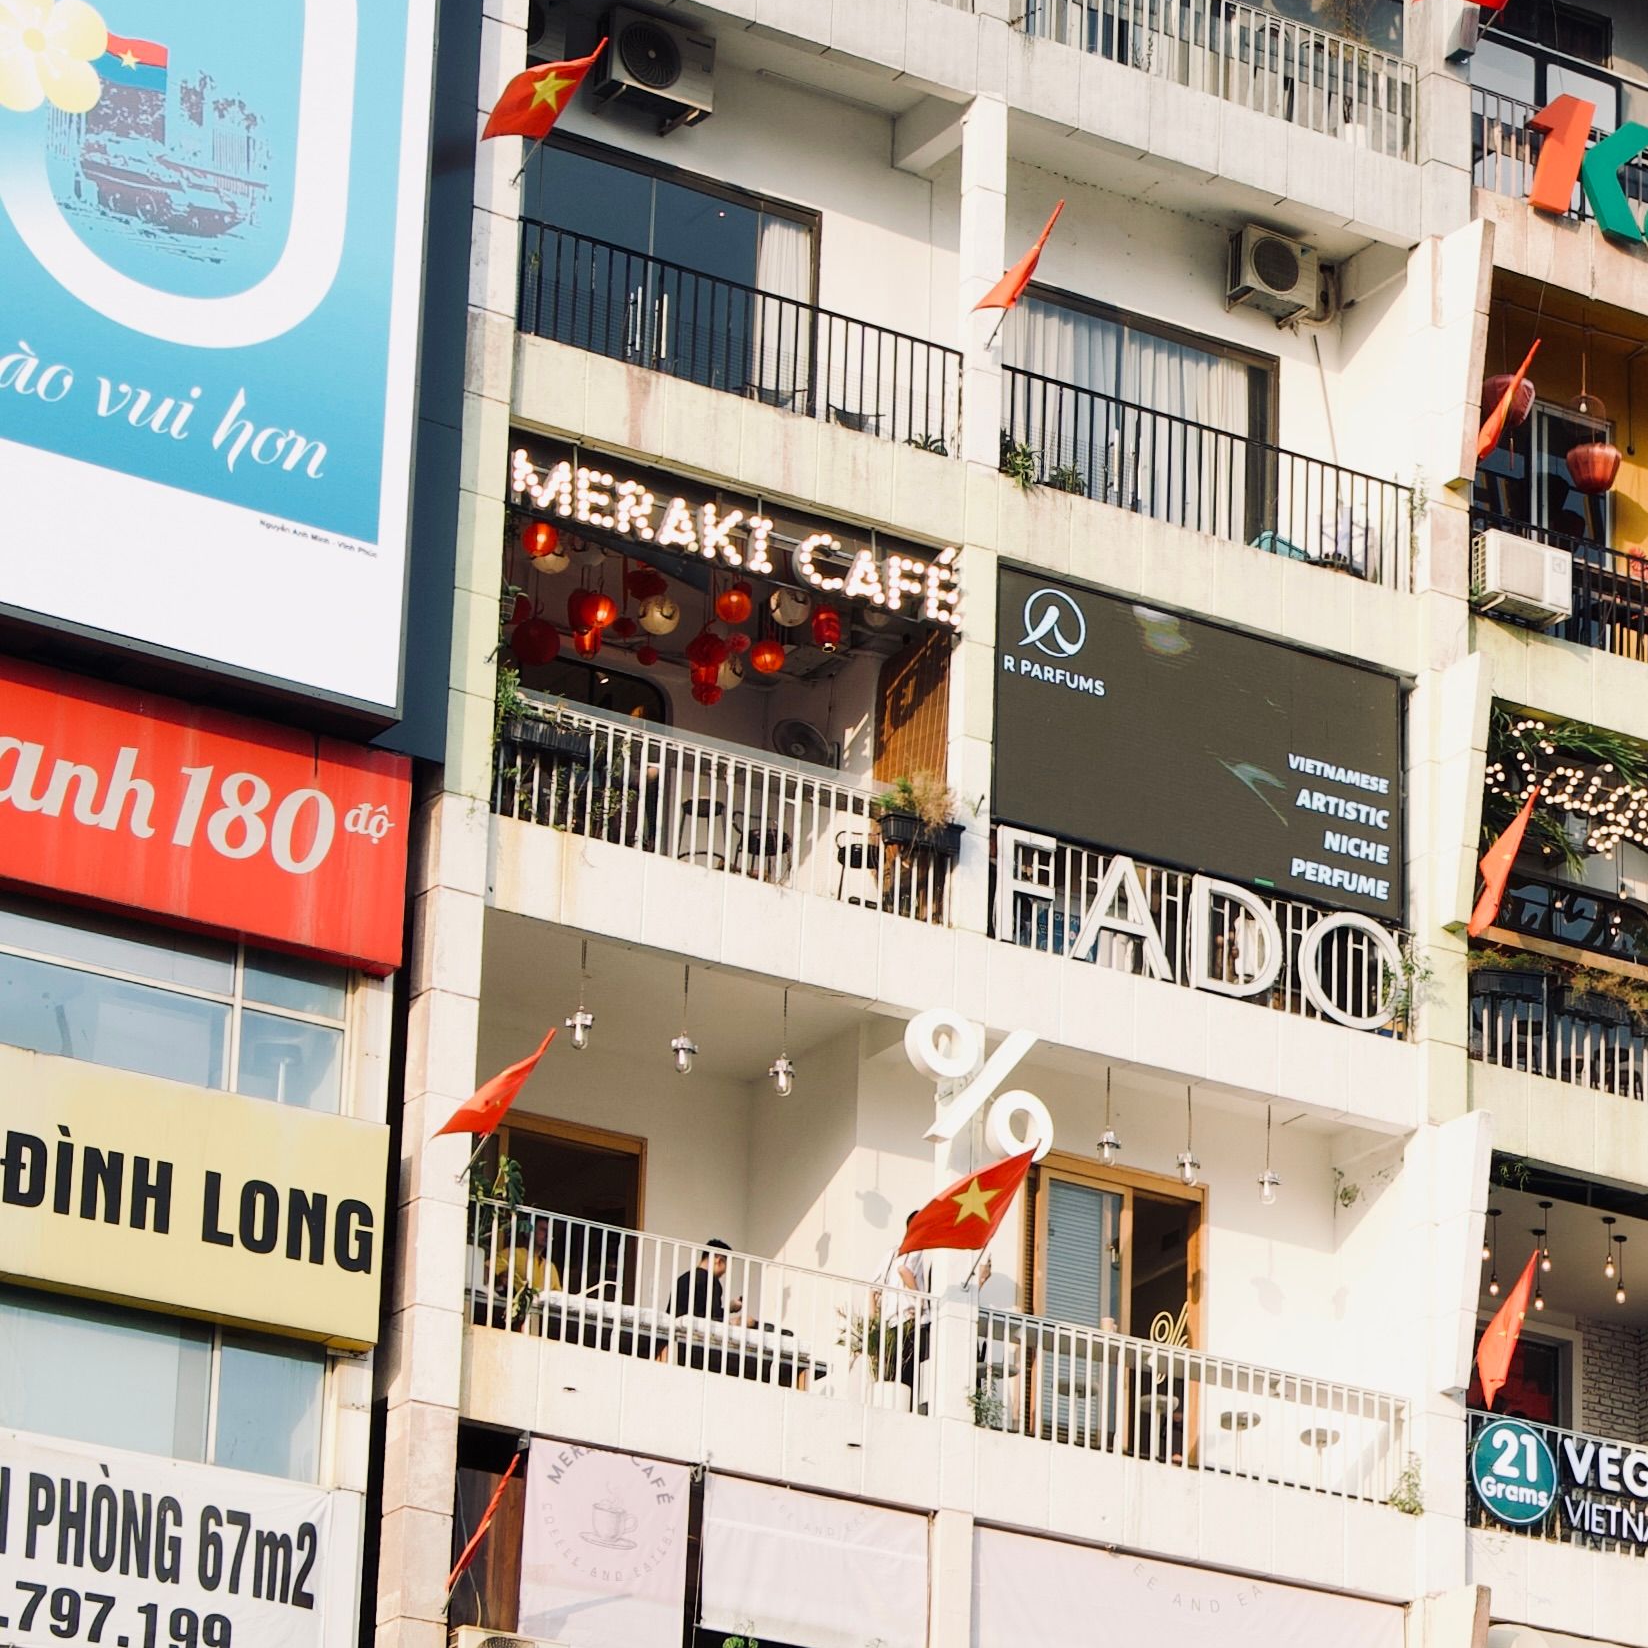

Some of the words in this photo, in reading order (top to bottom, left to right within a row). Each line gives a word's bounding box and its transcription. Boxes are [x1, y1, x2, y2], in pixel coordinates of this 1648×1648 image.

[96, 374, 202, 441] vui
[212, 387, 327, 479] hơn
[509, 447, 775, 575] MERAKI
[798, 531, 962, 628] CAFÉ
[1003, 654, 1015, 672] R
[1020, 659, 1105, 696] PARFUMS
[1288, 753, 1389, 794] VIETNAMESE
[170, 765, 335, 875] 180
[343, 801, 395, 845] độ
[1296, 788, 1389, 829] ARTISTIC
[1324, 830, 1389, 864] NICHE
[1290, 857, 1389, 900] PERFUME
[996, 825, 1402, 1031] FADO
[2, 1124, 174, 1234] ĐÌNH
[202, 1171, 373, 1274] LONG
[1492, 1428, 1538, 1483] 21
[1481, 1478, 1549, 1507] Grams
[26, 1465, 182, 1584] PHÒNG
[198, 1504, 318, 1611] 67m2
